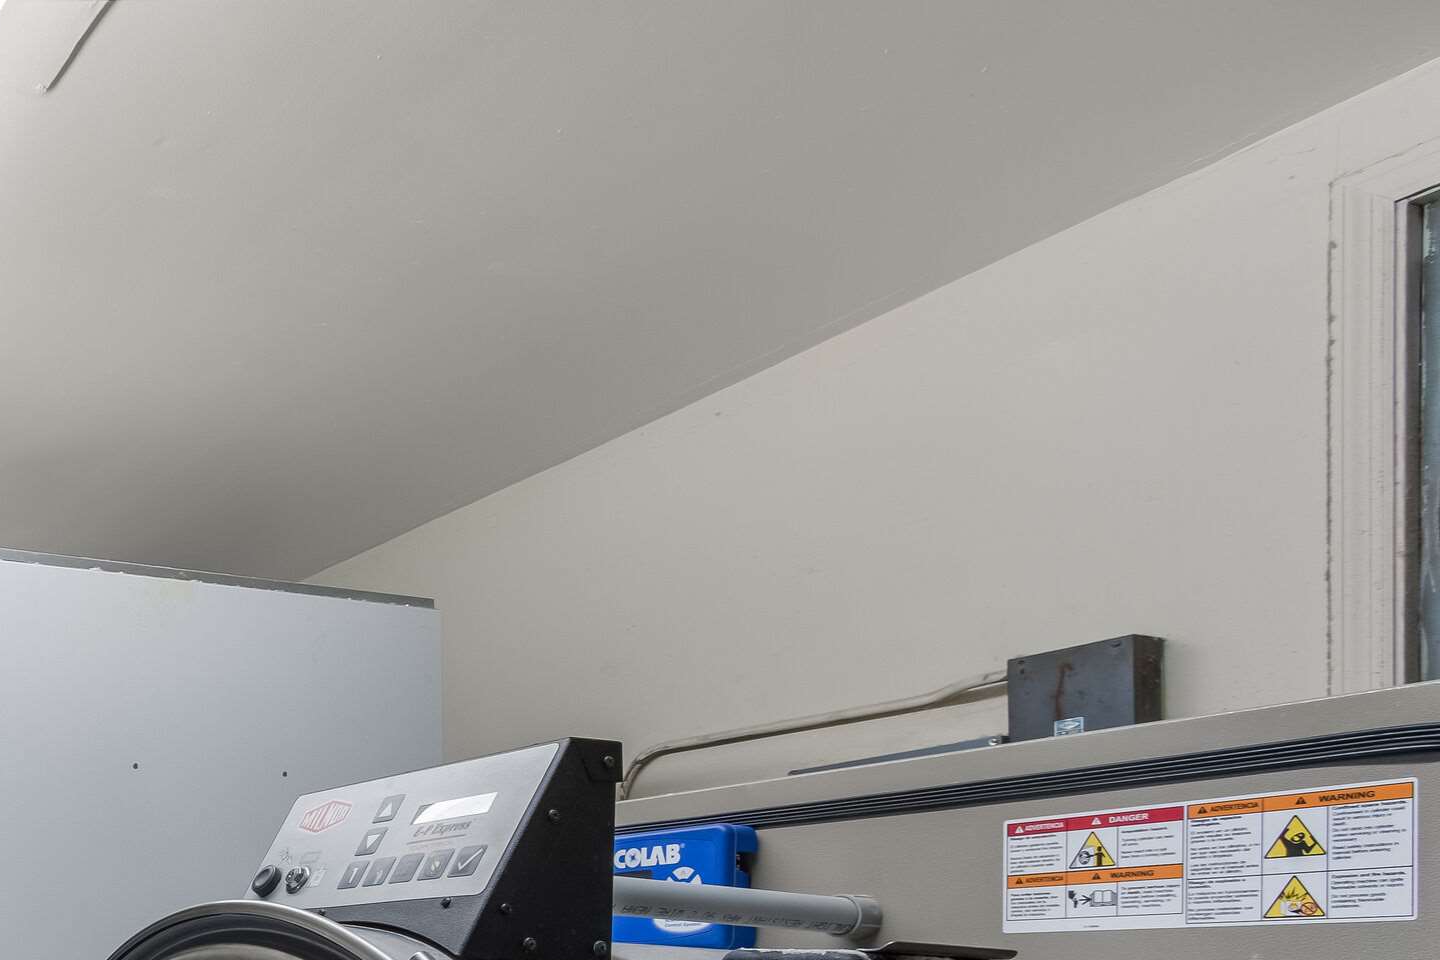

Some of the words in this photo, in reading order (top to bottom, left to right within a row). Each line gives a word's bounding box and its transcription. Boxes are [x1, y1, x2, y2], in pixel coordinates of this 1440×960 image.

[1318, 790, 1376, 803] WARNING
[1108, 813, 1149, 824] DANGER
[1110, 870, 1155, 879] WARNING
